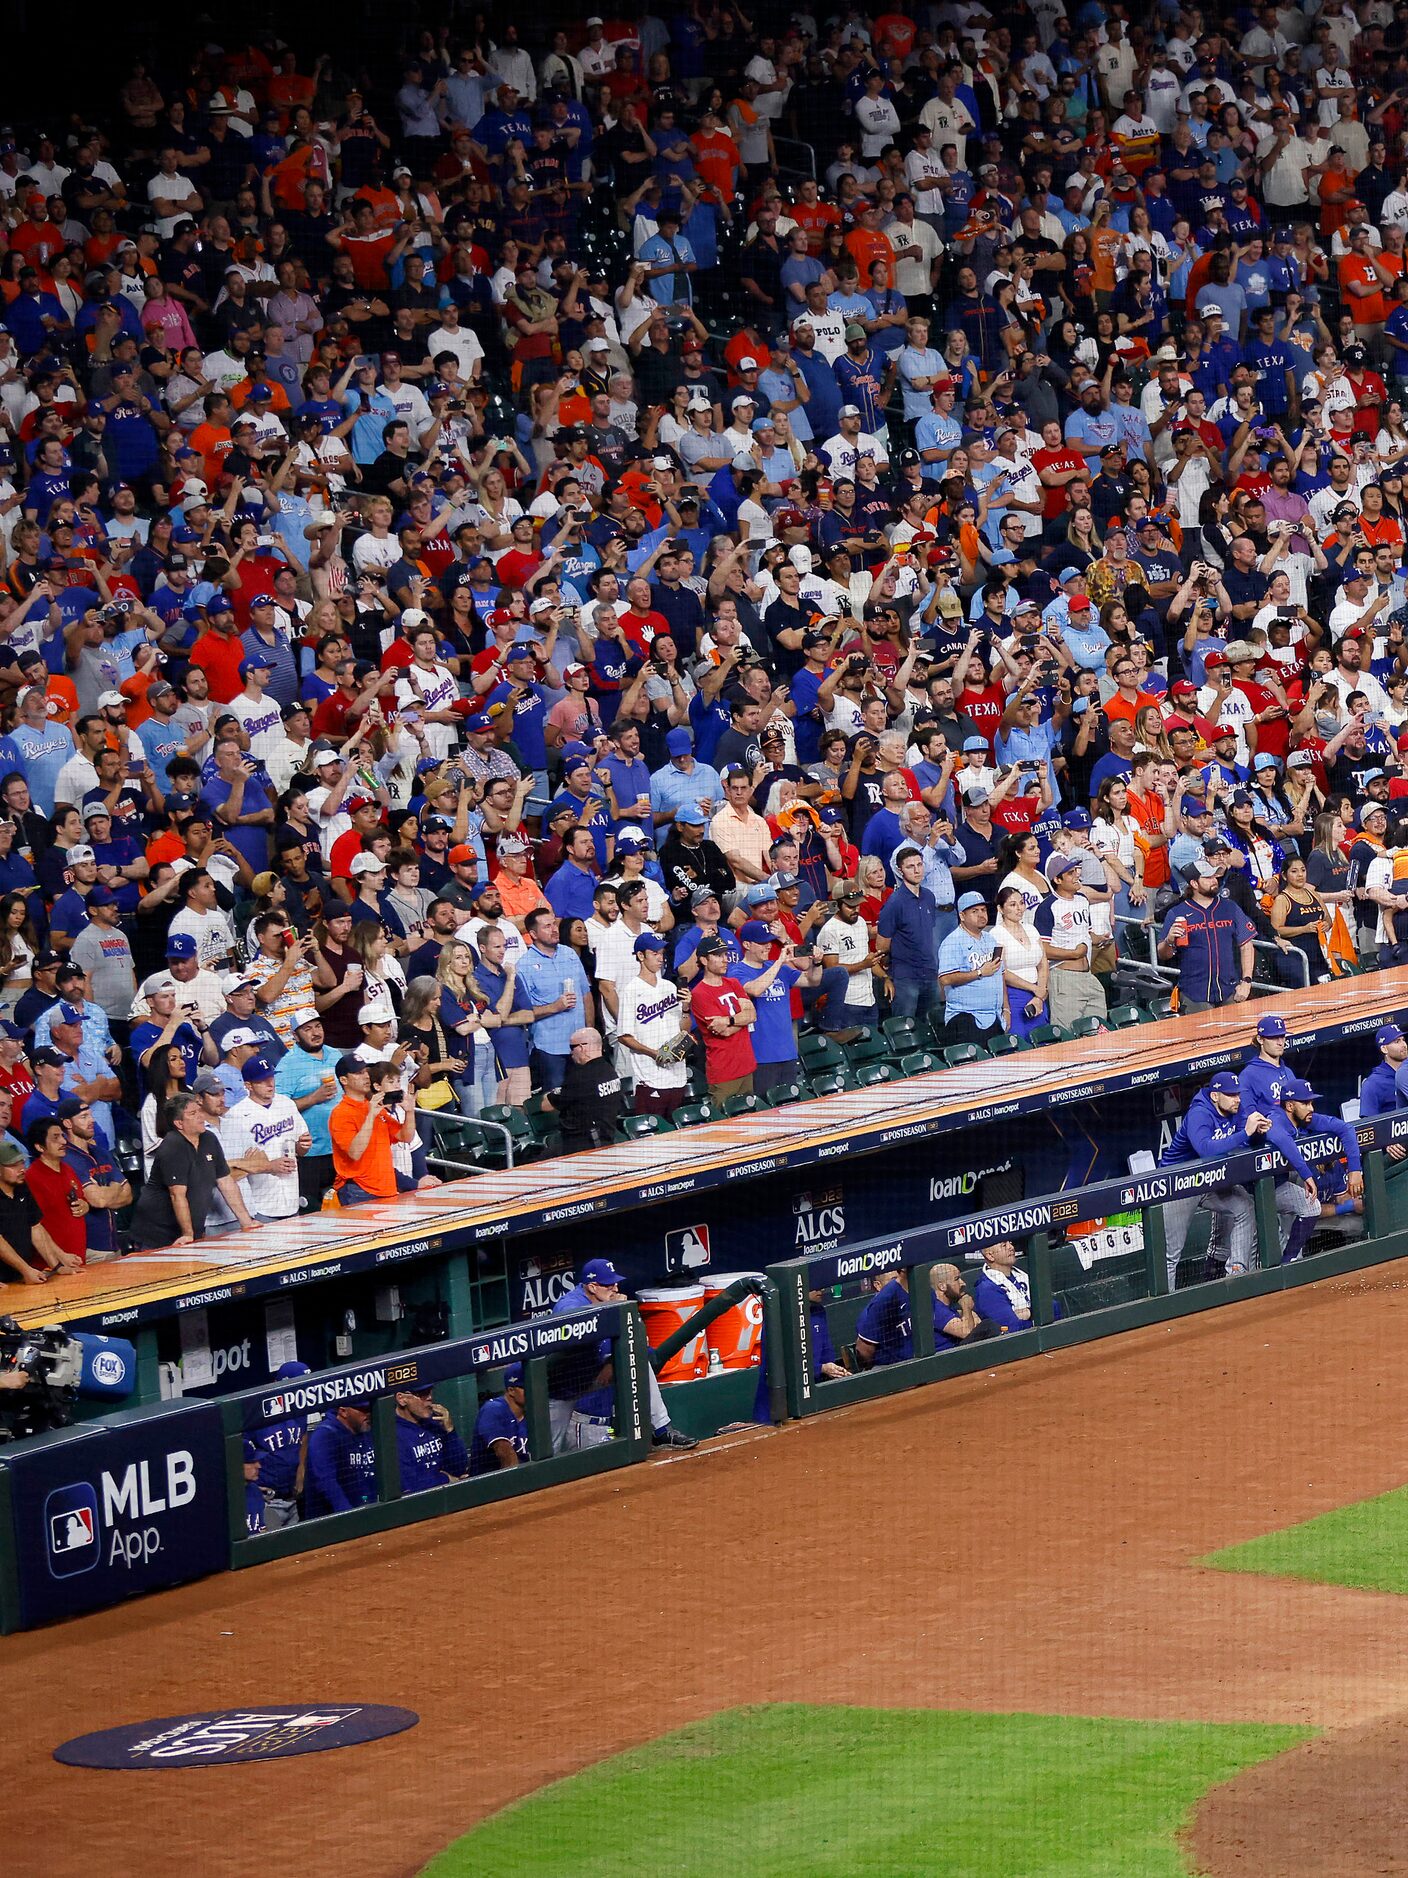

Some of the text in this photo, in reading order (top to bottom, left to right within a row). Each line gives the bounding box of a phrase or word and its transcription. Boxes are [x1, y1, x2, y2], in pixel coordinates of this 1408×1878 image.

[817, 327, 840, 337] POLO
[243, 710, 281, 738] Rangers
[22, 739, 68, 760] Rangers
[1215, 918, 1234, 930] CITY
[173, 940, 182, 951] KC
[636, 993, 680, 1025] Rangers
[719, 992, 740, 1015] T
[1349, 1018, 1383, 1033] POSTSEASON
[1292, 1034, 1316, 1046] loanDepot
[259, 1059, 269, 1070] T
[1195, 1053, 1231, 1069] POSTSEASON
[1132, 1070, 1159, 1084] loanDepot
[1058, 1085, 1093, 1103] POSTSEASON
[974, 1103, 1020, 1121] ALCS loanDepot
[251, 1116, 296, 1146] Rangers
[888, 1124, 926, 1140] POSTSEASON
[1356, 1131, 1375, 1144] 023
[819, 1143, 849, 1157] loanDepot
[735, 1160, 775, 1177] POSTSEASON
[647, 1180, 695, 1198] ALCS loanDepot
[1136, 1165, 1227, 1203] ALCS loanDepot
[550, 1202, 594, 1221] POSTSEASON
[966, 1203, 1078, 1238] POSTSEASON 2023
[475, 1222, 508, 1238] loanDepot
[795, 1206, 845, 1243] ALCS
[385, 1241, 429, 1260] POSTSEASON
[803, 1238, 838, 1255] loanDepot
[837, 1242, 902, 1278] loanDepot
[289, 1263, 341, 1284] ALCS loanDepot
[186, 1289, 231, 1306] POSTSEASON
[522, 1272, 575, 1310] ALCS
[102, 1309, 138, 1326] loanDepot
[492, 1316, 599, 1361] ALCS loanDepot
[797, 1274, 811, 1399] ASTROS.COM
[99, 1358, 119, 1373] FOX
[627, 1312, 642, 1440] ASTROS.COM
[284, 1366, 418, 1413] POSTSEASON 2023
[101, 1450, 197, 1527] MLB
[109, 1527, 161, 1569] App
[151, 1712, 297, 1758] ALCS
